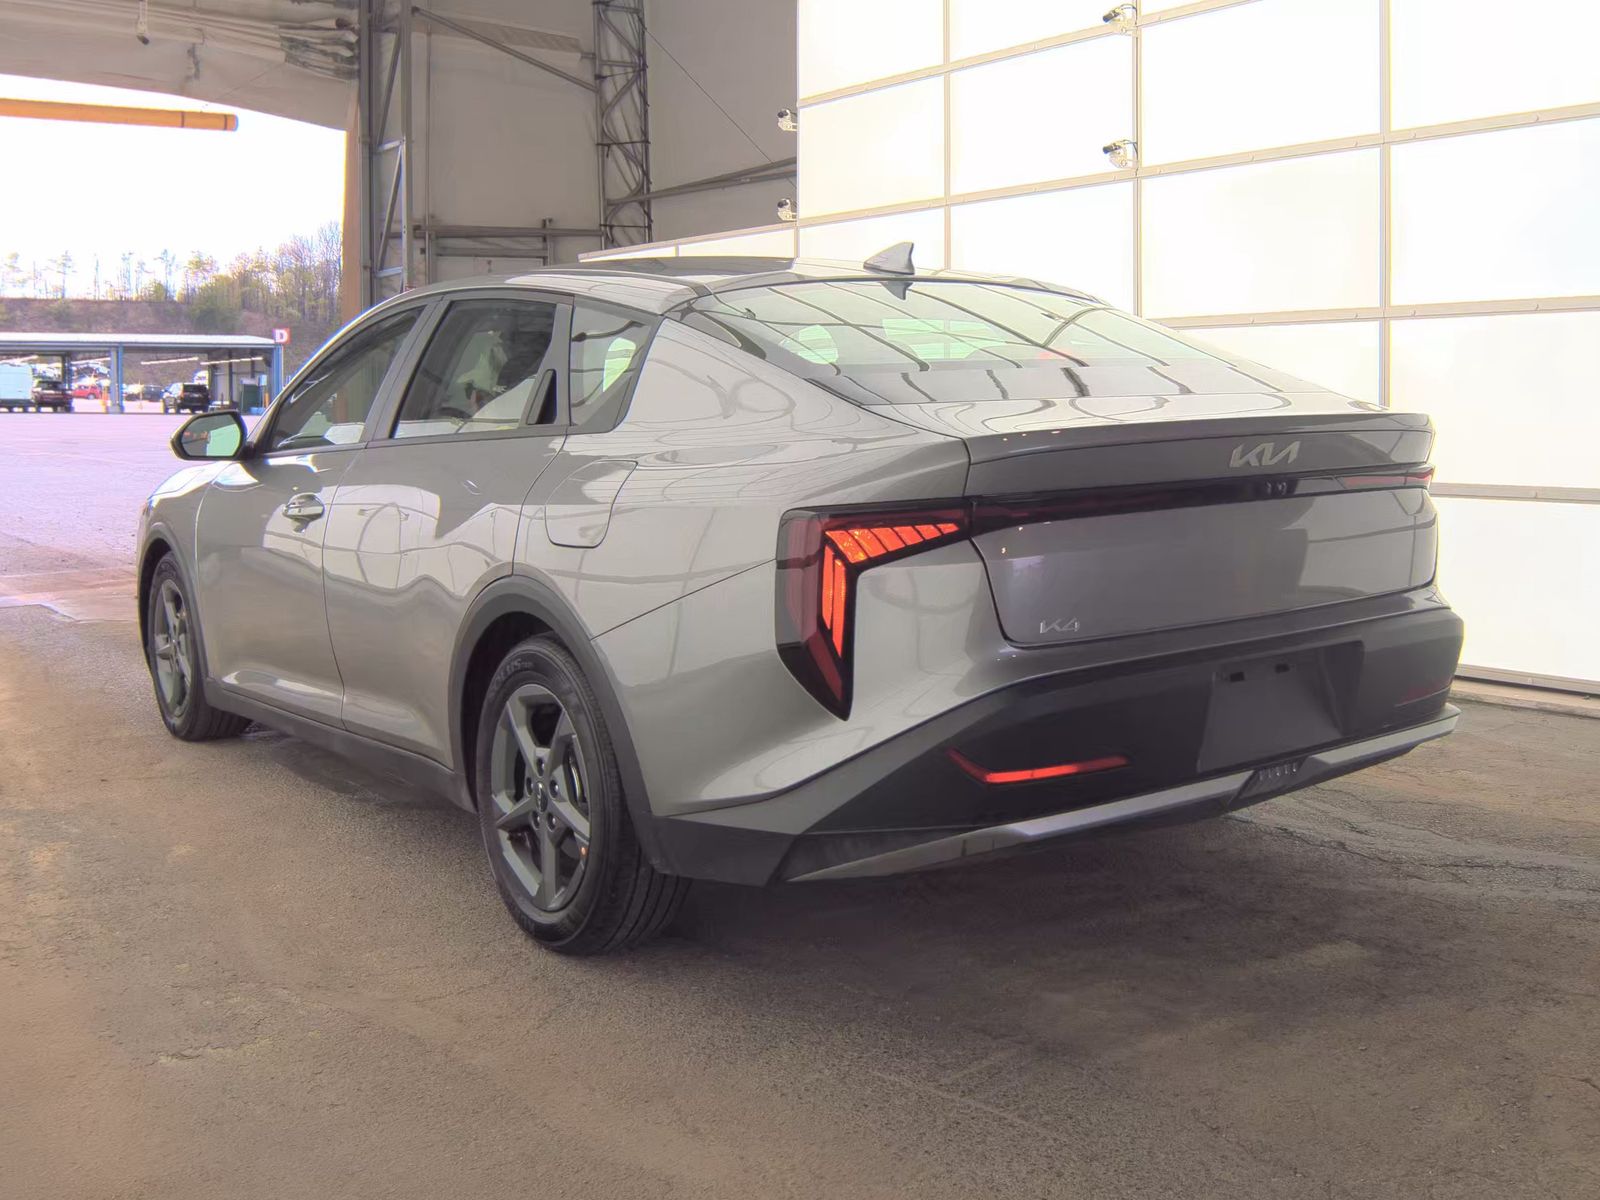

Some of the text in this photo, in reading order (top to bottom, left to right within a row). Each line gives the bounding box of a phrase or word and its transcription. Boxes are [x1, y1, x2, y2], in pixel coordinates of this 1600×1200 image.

[275, 329, 288, 342] D
[1229, 440, 1301, 468] KIA
[1039, 617, 1081, 634] K4
